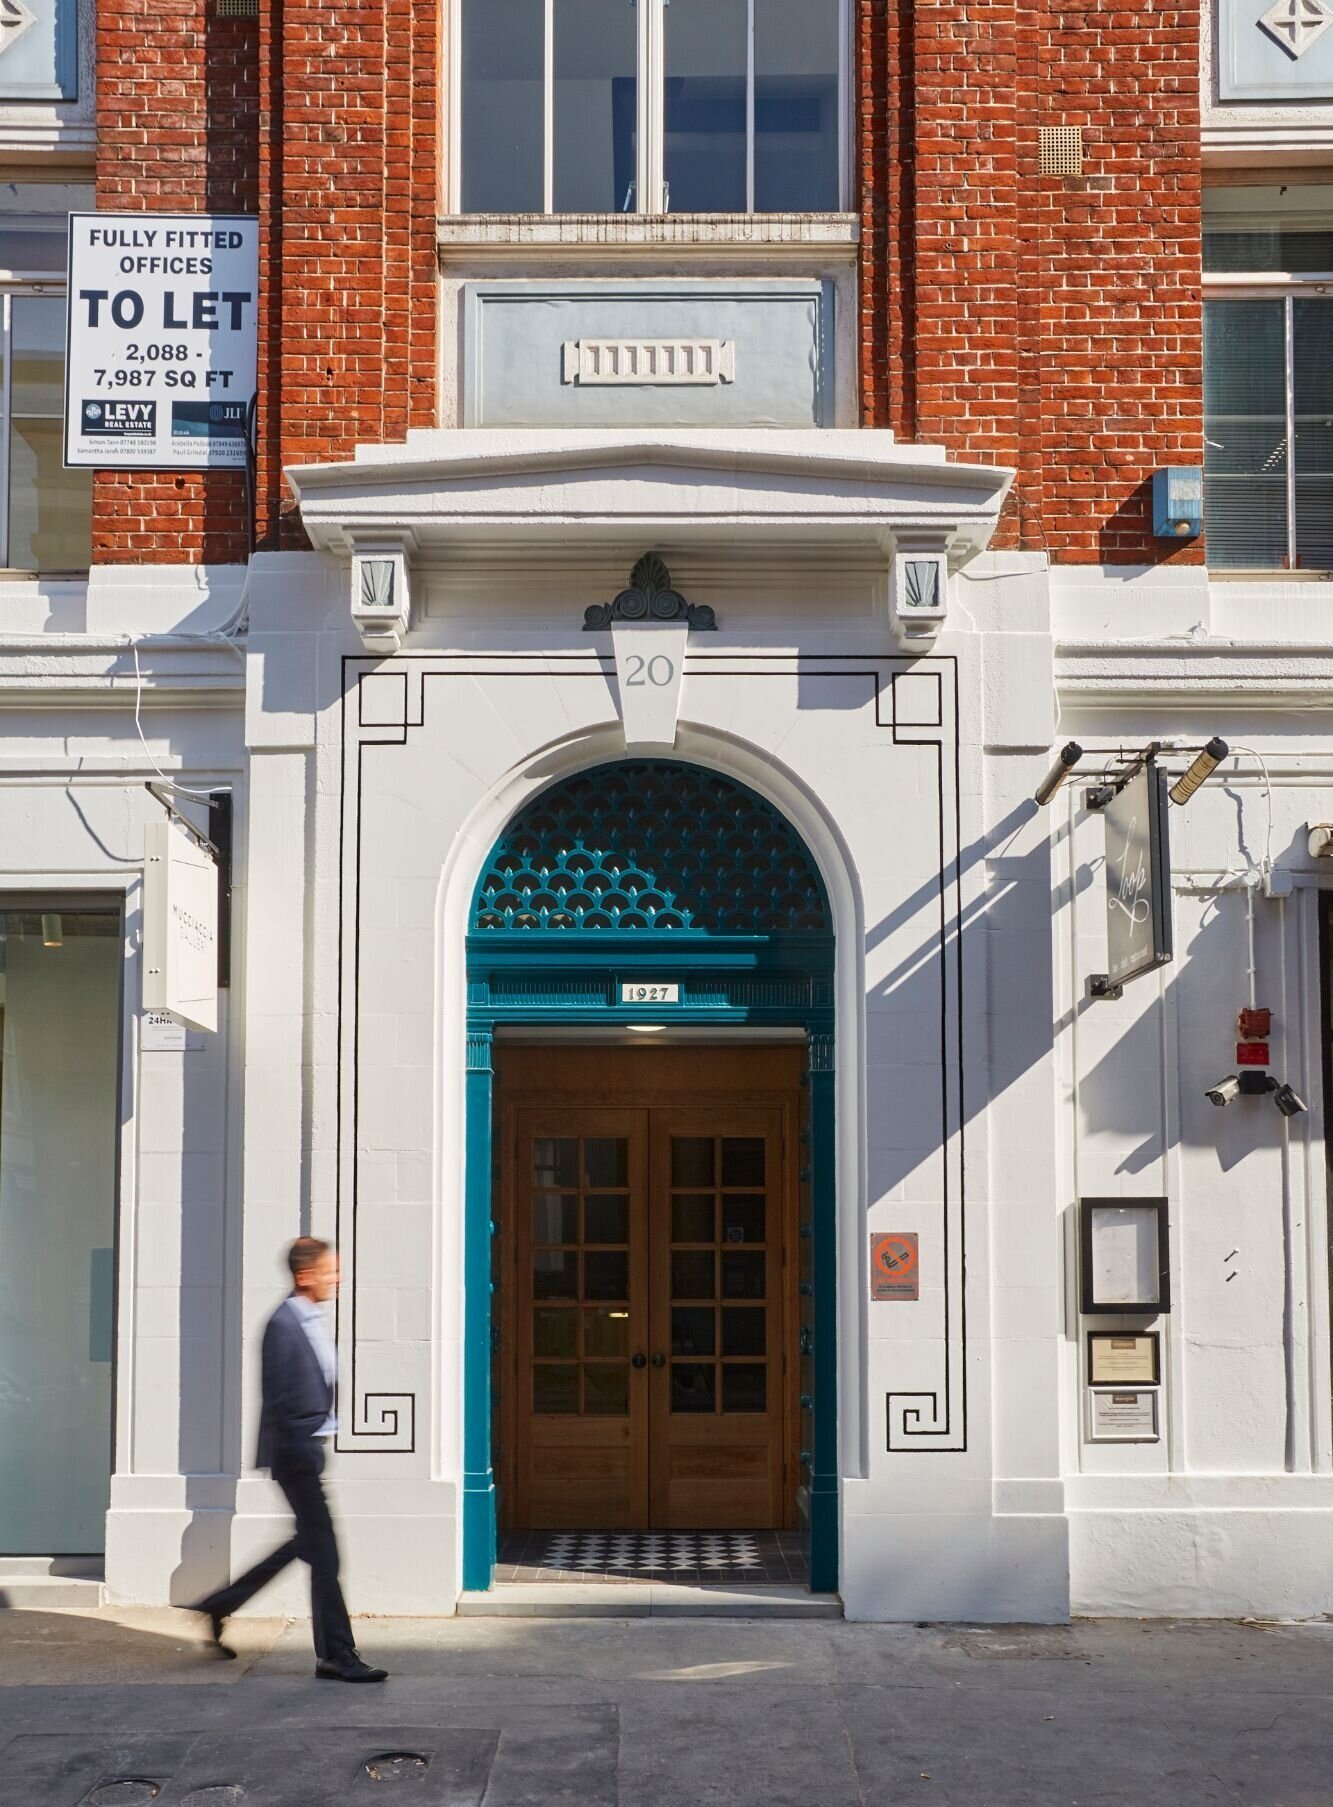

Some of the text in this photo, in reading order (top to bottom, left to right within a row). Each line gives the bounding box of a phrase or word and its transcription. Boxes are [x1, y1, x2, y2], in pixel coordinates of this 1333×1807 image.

[90, 229, 243, 248] FULLY FITTED
[120, 256, 212, 274] OFFICES
[80, 290, 252, 330] TO LET
[126, 344, 188, 364] 2,088
[94, 370, 233, 389] 7,987 SQ FT
[104, 404, 152, 420] LEVY
[626, 655, 674, 686] 20
[628, 987, 668, 1000] 1927
